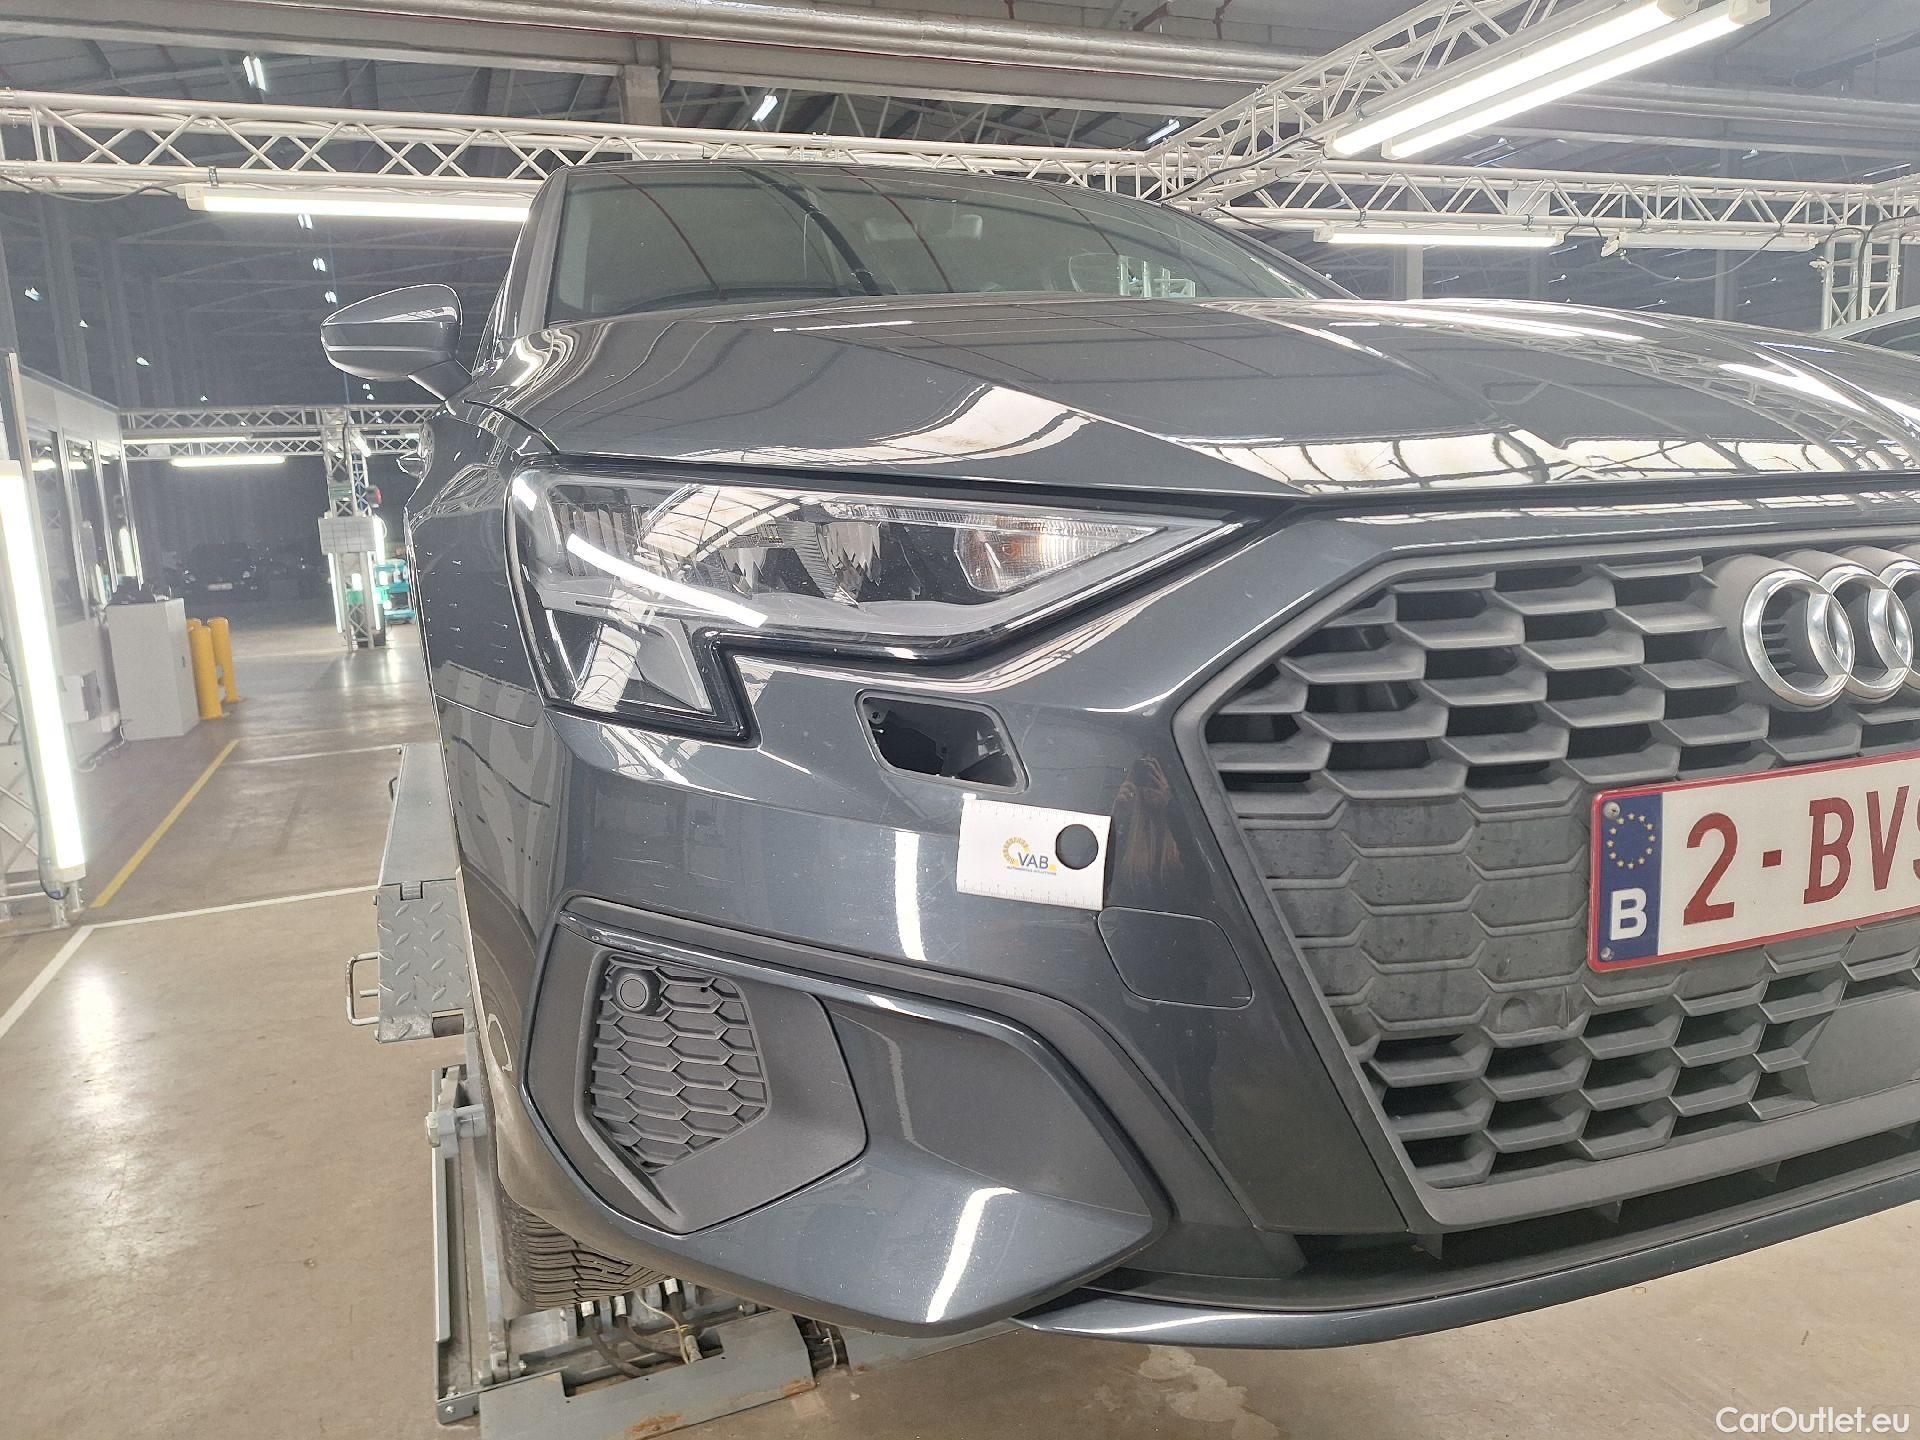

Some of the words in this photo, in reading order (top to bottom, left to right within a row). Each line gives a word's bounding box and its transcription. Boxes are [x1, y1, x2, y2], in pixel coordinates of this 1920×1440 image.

[1018, 852, 1049, 869] VAB
[1683, 785, 1920, 926] 2-BV
[1610, 887, 1648, 941] B
